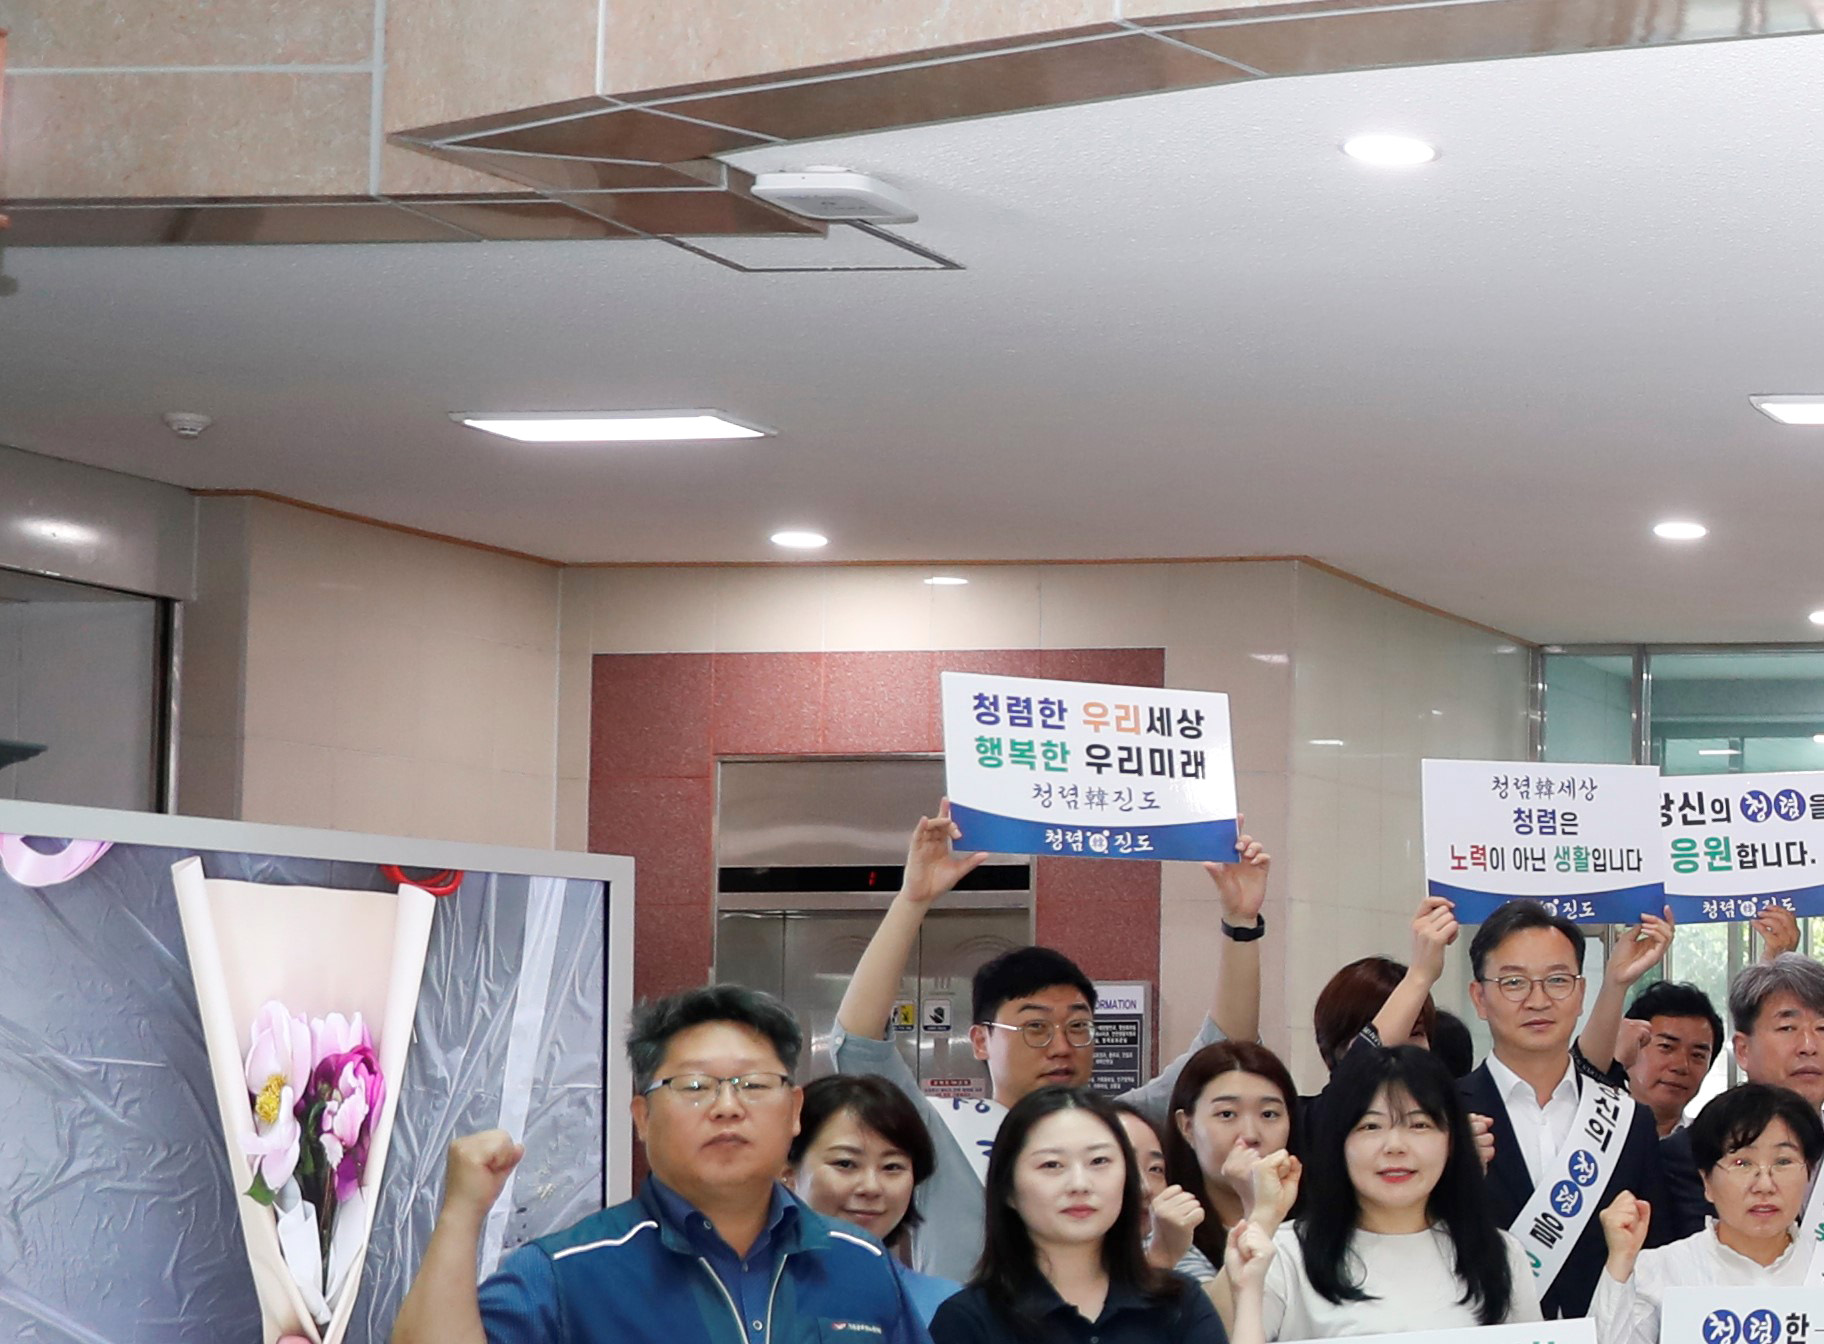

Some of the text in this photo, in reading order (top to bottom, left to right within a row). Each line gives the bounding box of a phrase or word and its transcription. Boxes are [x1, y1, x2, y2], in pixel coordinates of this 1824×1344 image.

[972, 692, 1205, 739] 청렴한 우리세상
[974, 735, 1206, 779] 행복한 우리미래
[1512, 807, 1579, 836] 청렴은
[1449, 845, 1643, 874] 노력이 아닌 생활입니다
[1670, 835, 1817, 875] 응원합니다.
